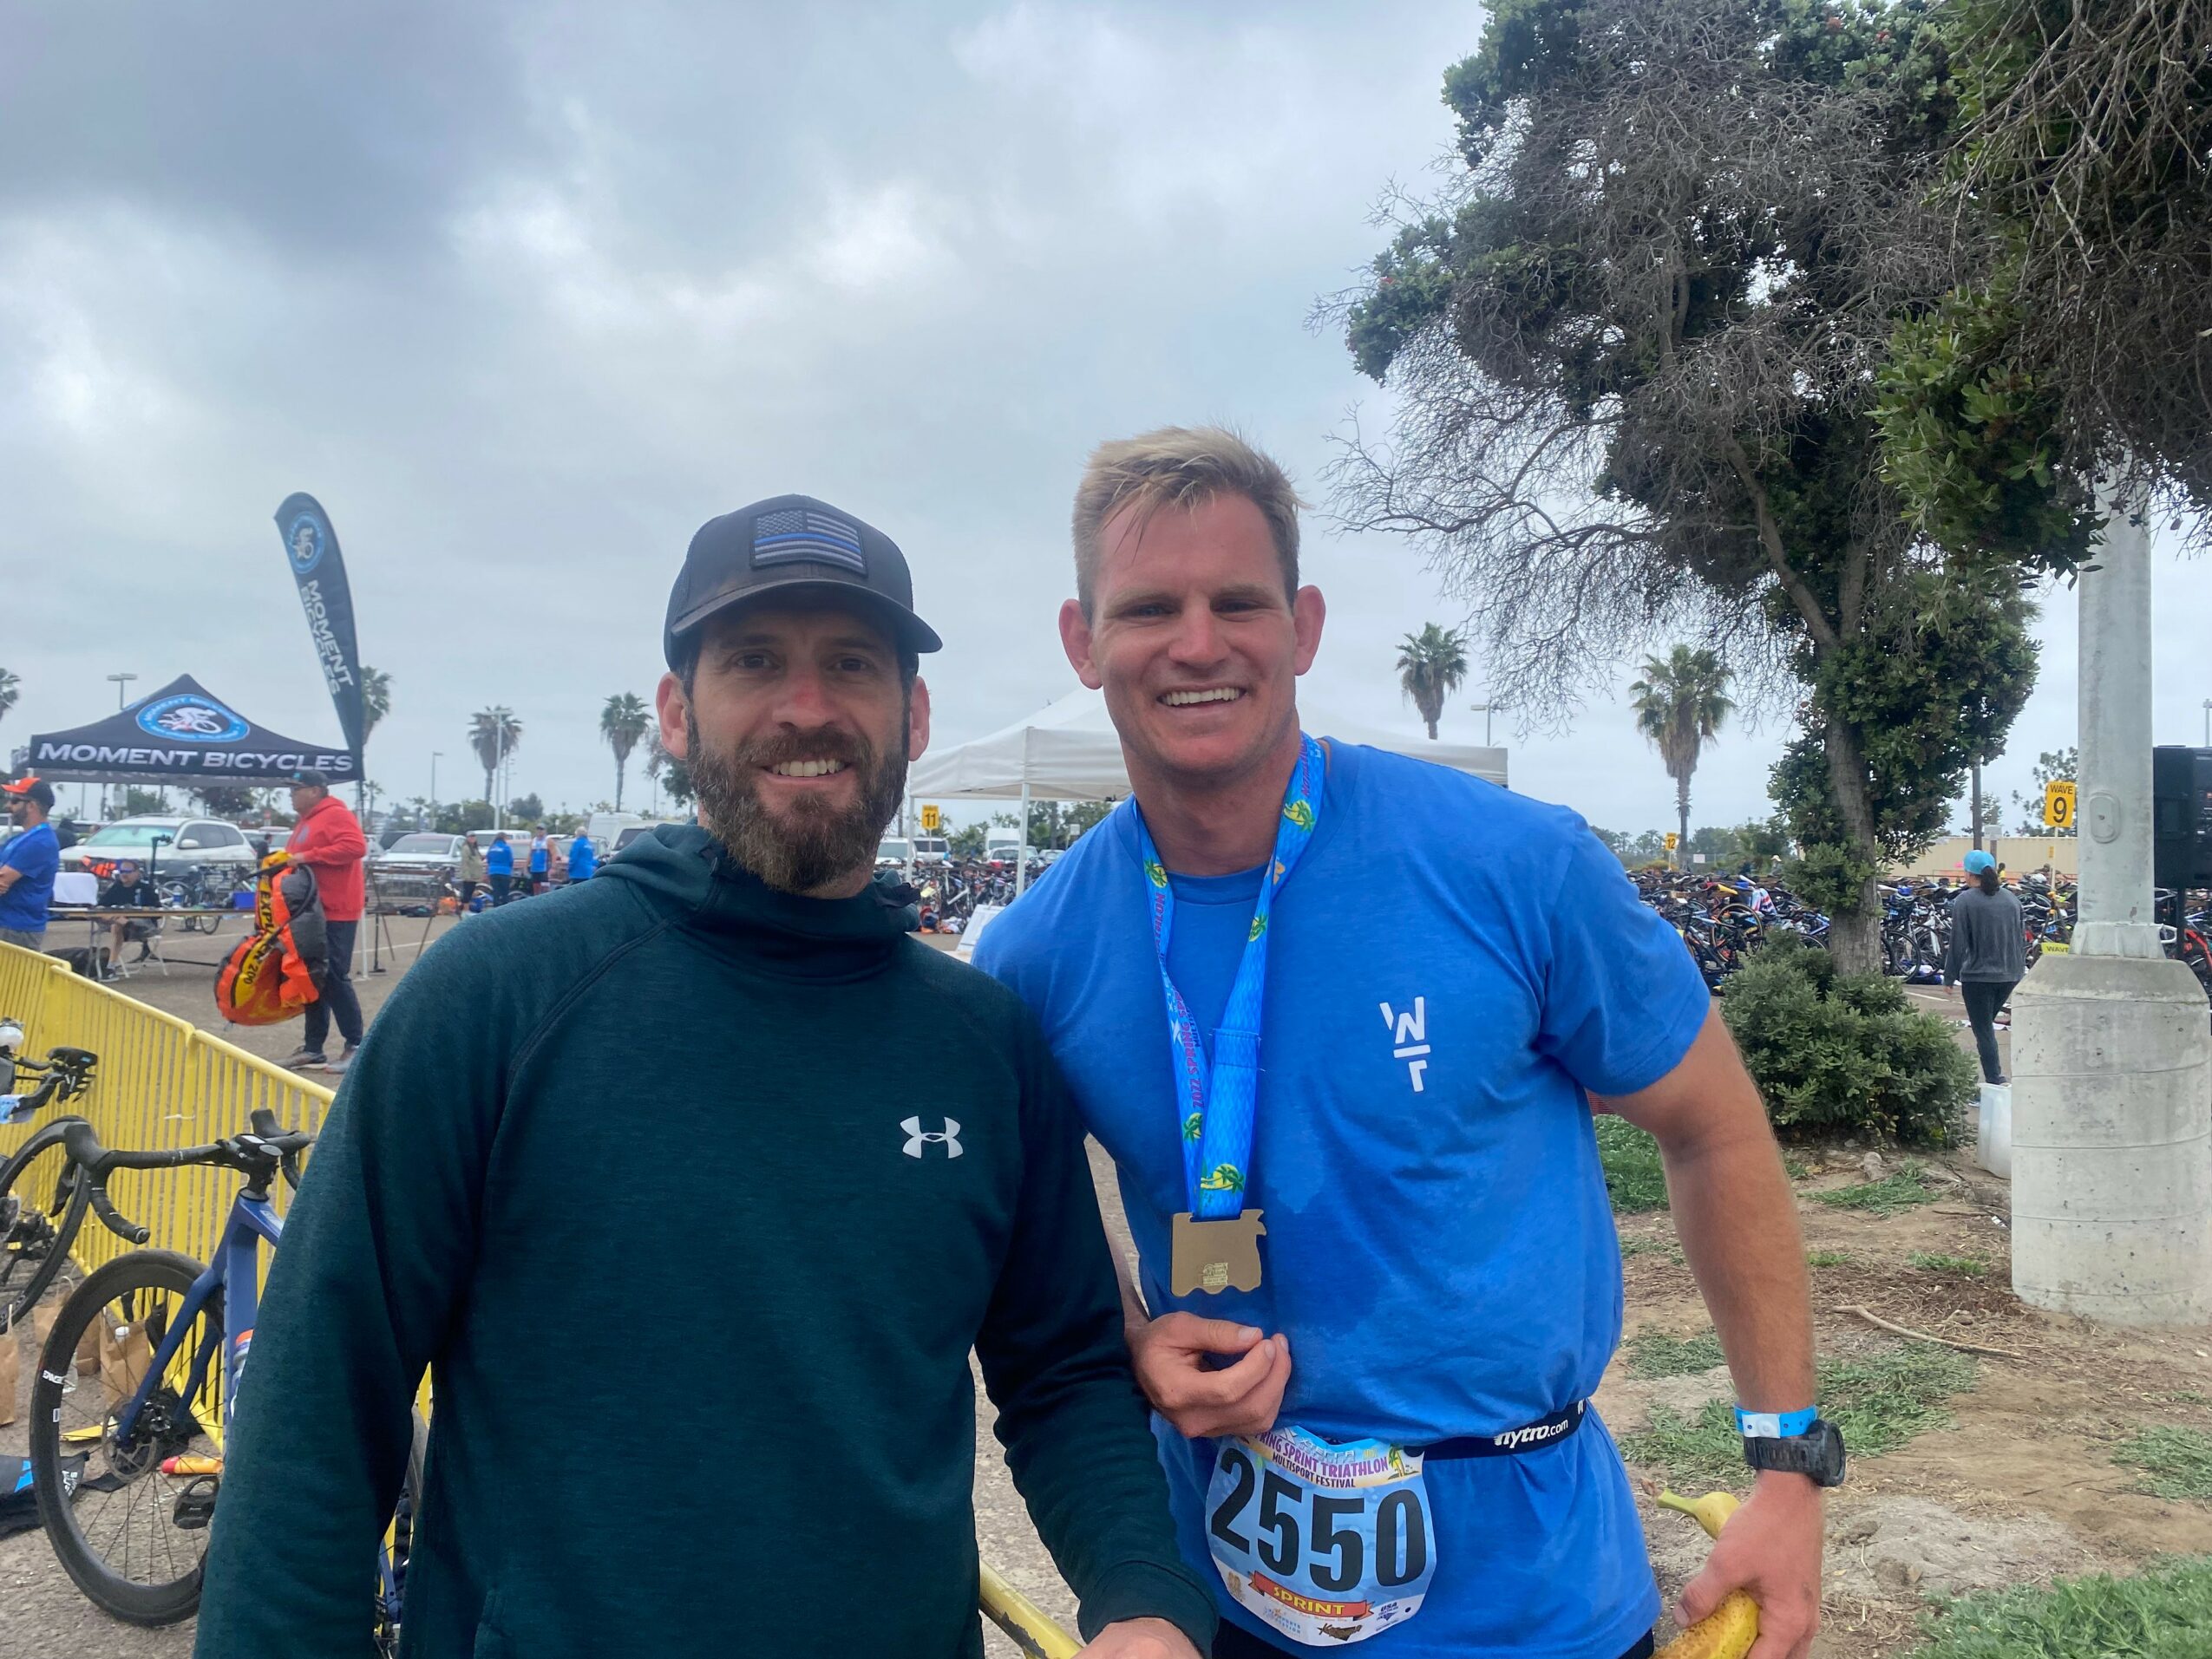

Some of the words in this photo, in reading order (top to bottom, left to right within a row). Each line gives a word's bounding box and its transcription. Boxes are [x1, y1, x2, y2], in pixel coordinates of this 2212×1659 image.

[301, 586, 341, 695] BICYCLES
[307, 579, 354, 686] MOMENT
[37, 742, 198, 766] MOMENT
[203, 752, 353, 771] BICYCLES
[2050, 785, 2073, 794] WAVE
[925, 813, 936, 826] 11
[2052, 797, 2067, 823] 9
[1667, 838, 1676, 849] 12
[244, 963, 259, 985] 200
[1181, 1022, 1198, 1075] SPRING
[1494, 1419, 1568, 1448] nytro.com
[1272, 1451, 1315, 1483] MULTISPORT
[1315, 1476, 1357, 1488] FESTIVAL
[1283, 1441, 1319, 1473] SPRINT
[1321, 1456, 1389, 1478] TRIATHLON
[1211, 1447, 1427, 1592] 2550
[1273, 1586, 1345, 1616] SPRINT
[1380, 1602, 1398, 1612] USA
